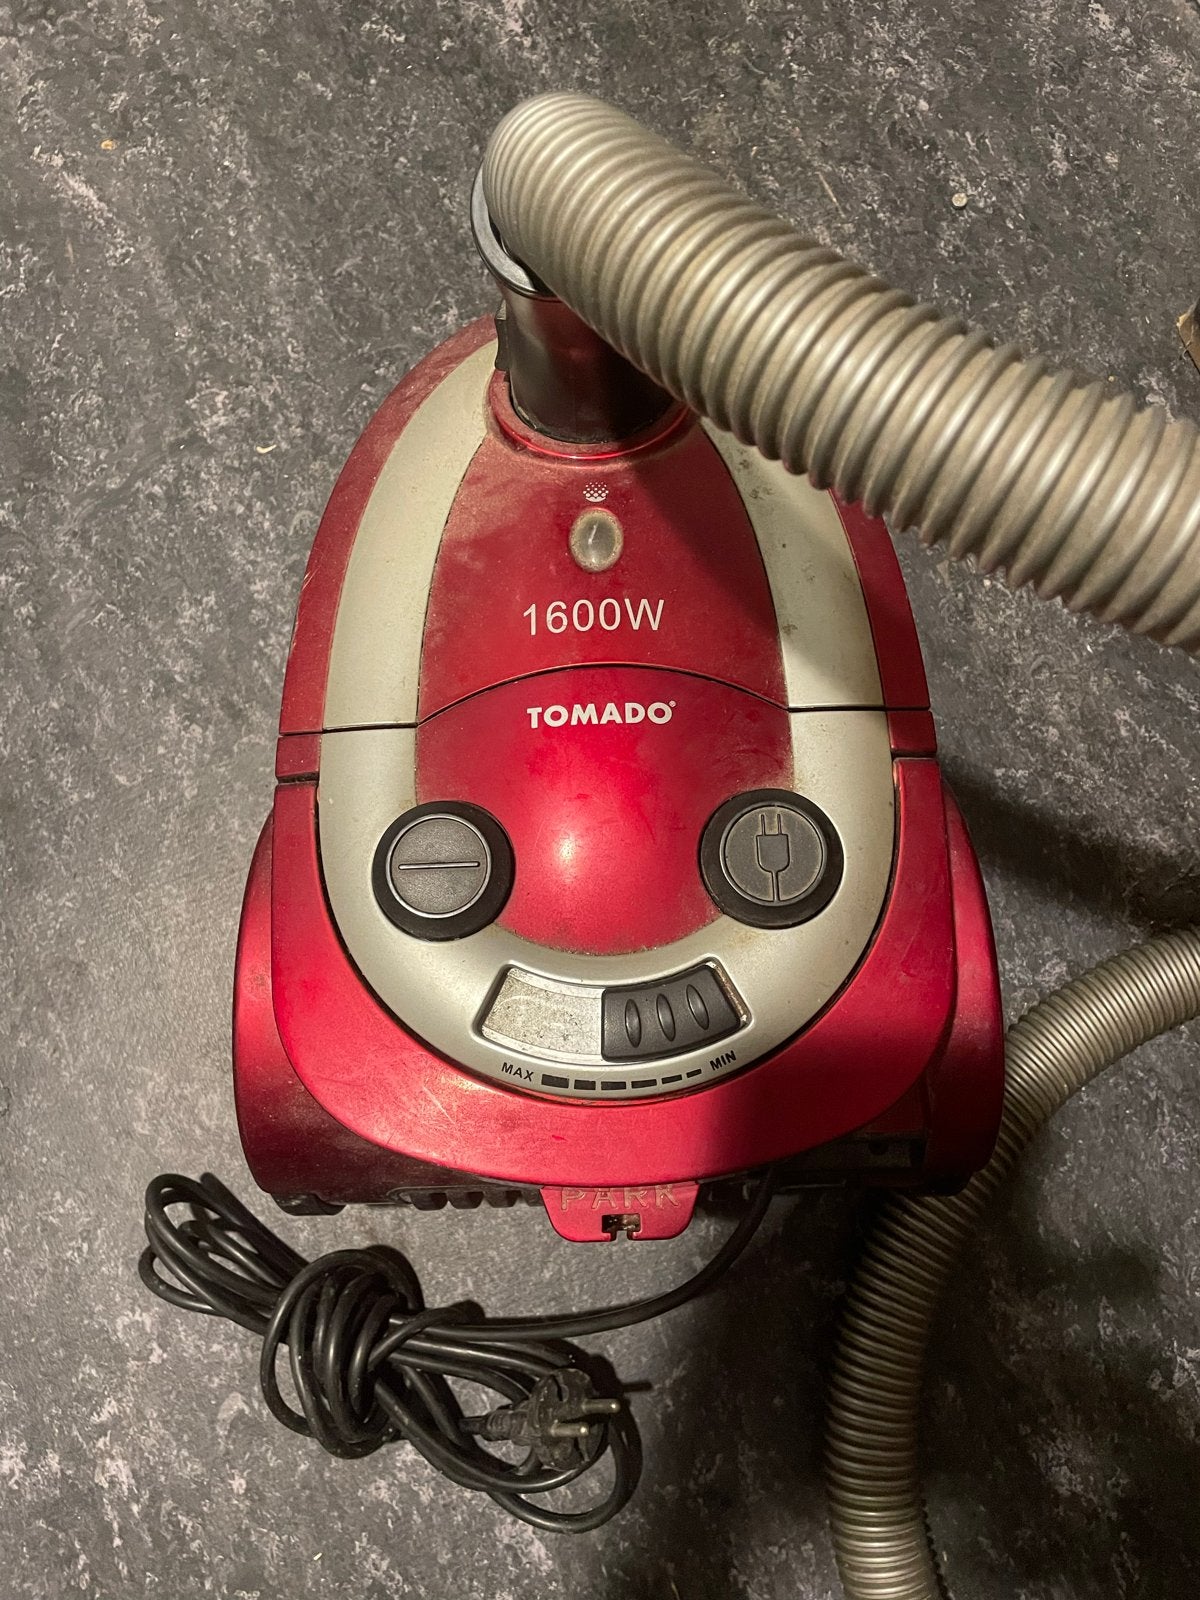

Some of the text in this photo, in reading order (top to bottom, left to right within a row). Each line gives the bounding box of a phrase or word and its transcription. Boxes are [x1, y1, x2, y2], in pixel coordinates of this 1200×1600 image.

[523, 598, 665, 636] 1600W
[501, 1050, 737, 1082] MAX MIN
[561, 1184, 680, 1211] PARK
